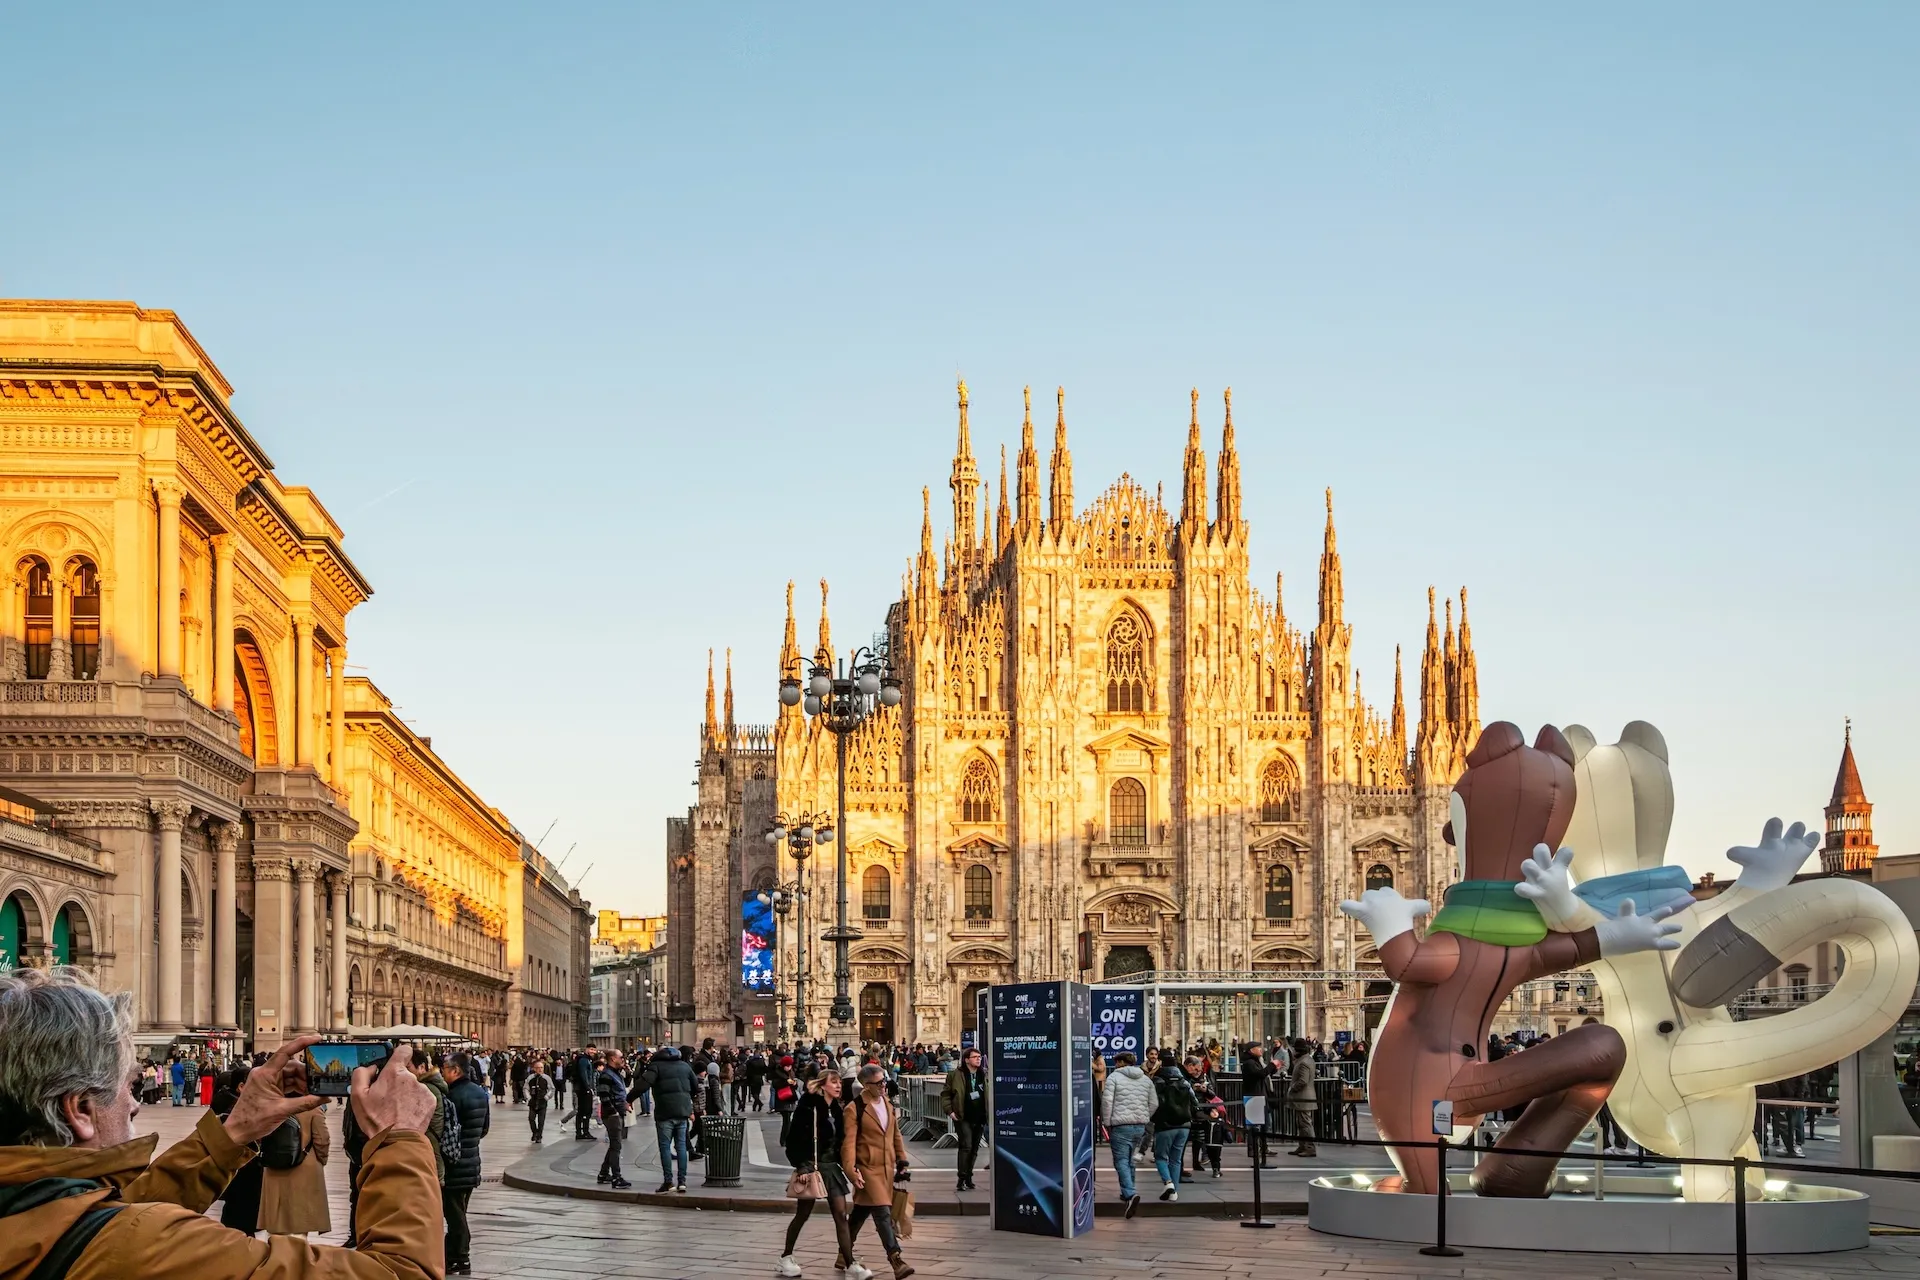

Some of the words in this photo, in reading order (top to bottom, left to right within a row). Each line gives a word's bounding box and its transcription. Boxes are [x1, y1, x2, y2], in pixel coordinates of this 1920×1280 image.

[1100, 1008, 1137, 1023] ONE
[1091, 1022, 1126, 1036] EAR
[1110, 1035, 1138, 1050] GO
